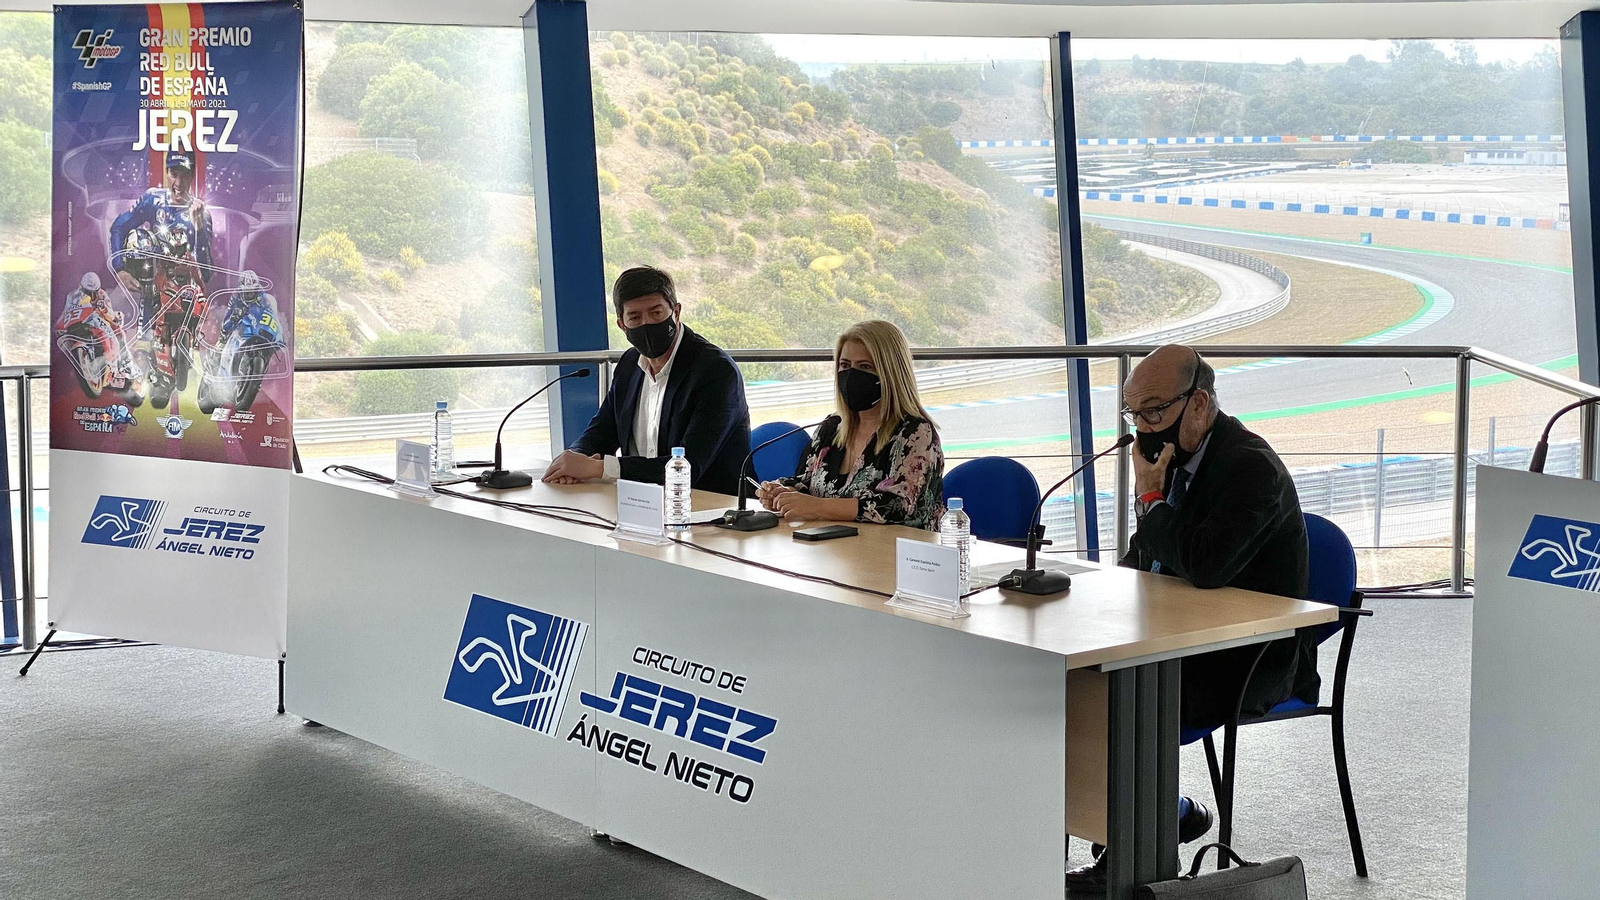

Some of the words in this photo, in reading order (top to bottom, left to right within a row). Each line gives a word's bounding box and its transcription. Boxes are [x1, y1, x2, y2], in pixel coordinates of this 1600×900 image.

[139, 28, 183, 47] GRAN
[188, 26, 252, 46] PREMIO
[139, 52, 170, 71] RED
[174, 52, 215, 71] BULL
[72, 81, 112, 91] #SpanishGP
[139, 76, 160, 96] DE
[164, 72, 229, 96] ESPAÑA
[139, 99, 149, 108] 30
[187, 99, 207, 108] MAYO
[208, 99, 227, 108] 2021
[132, 109, 239, 153] JEREZ
[259, 313, 278, 332] 36
[168, 422, 180, 432] FIM
[193, 505, 236, 517] CIRCUITO
[238, 510, 252, 518] DE
[162, 517, 266, 544] JEREZ
[155, 537, 205, 555] ÁNGEL
[209, 545, 255, 560] NIETO
[632, 646, 716, 684] CIRCUITO
[718, 671, 748, 694] DE
[579, 671, 779, 765] JEREZ
[566, 714, 657, 773] ÁNGEL
[663, 751, 755, 803] NIETO
